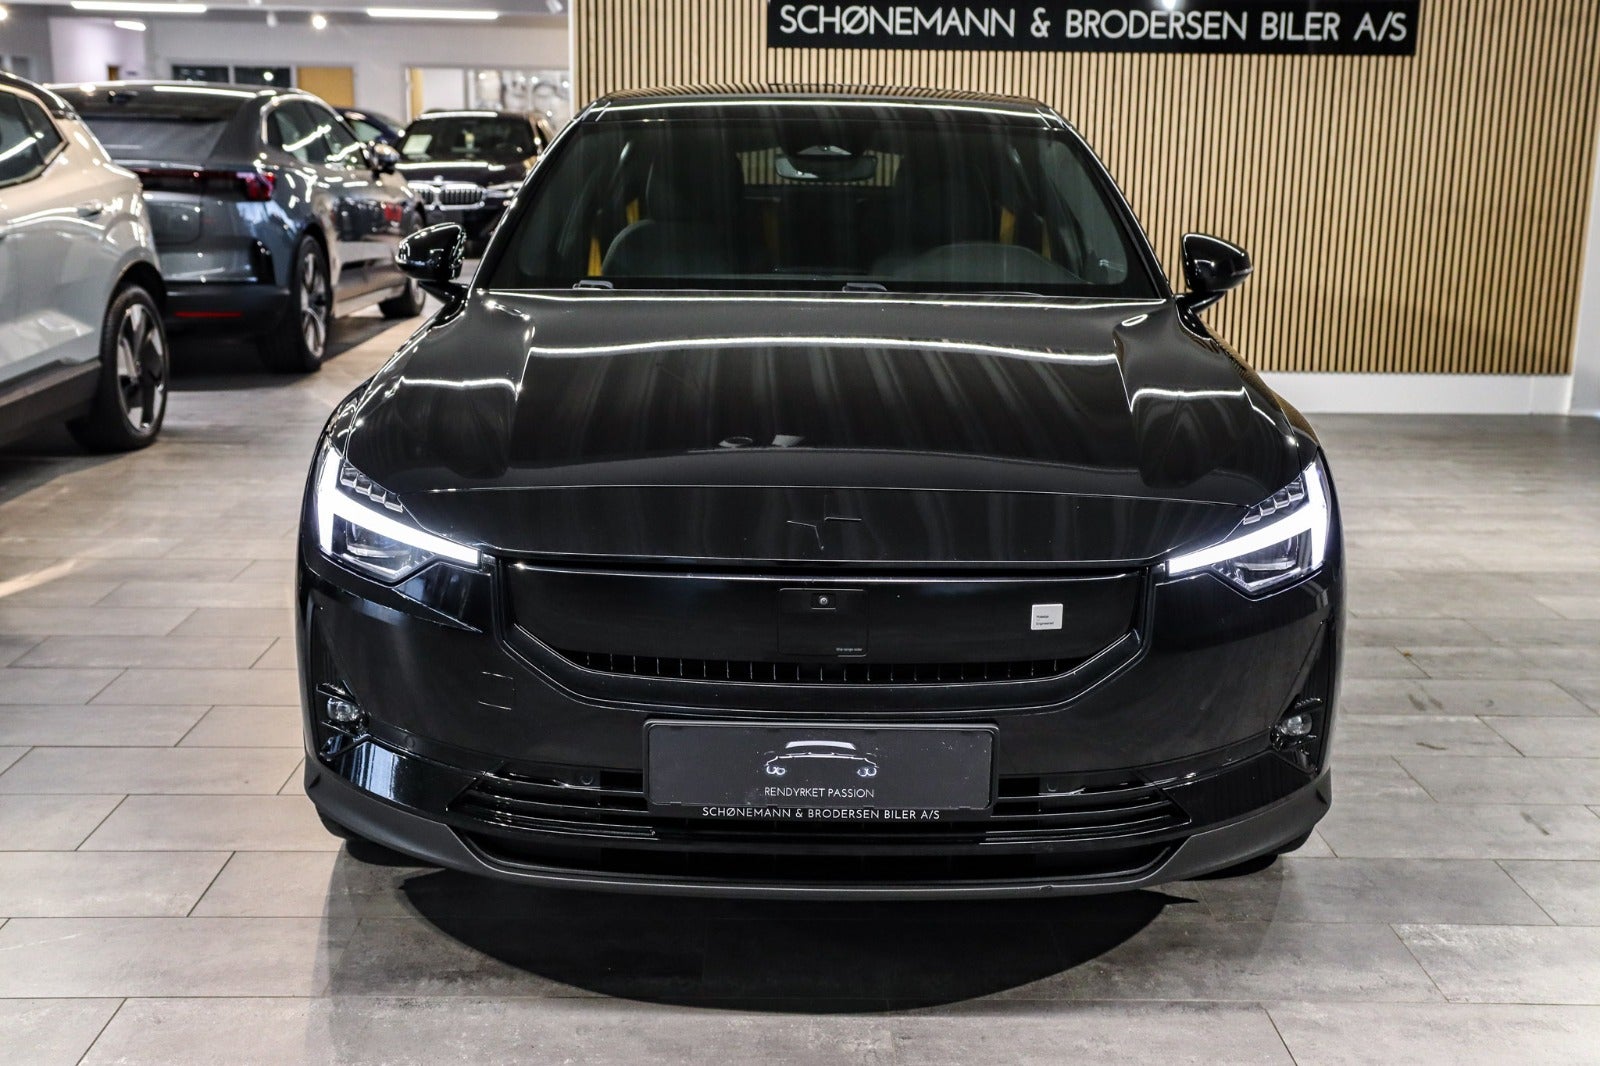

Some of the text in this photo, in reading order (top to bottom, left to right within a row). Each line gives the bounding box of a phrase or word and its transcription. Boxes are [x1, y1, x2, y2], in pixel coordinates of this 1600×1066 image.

[780, 5, 1407, 42] SCHØNEMANN & BRODERSEN BILER A/S
[764, 787, 875, 798] RENDYRKET PASSION
[702, 806, 940, 820] SCHØNEMANN & BRODERSEN BILER A/S
